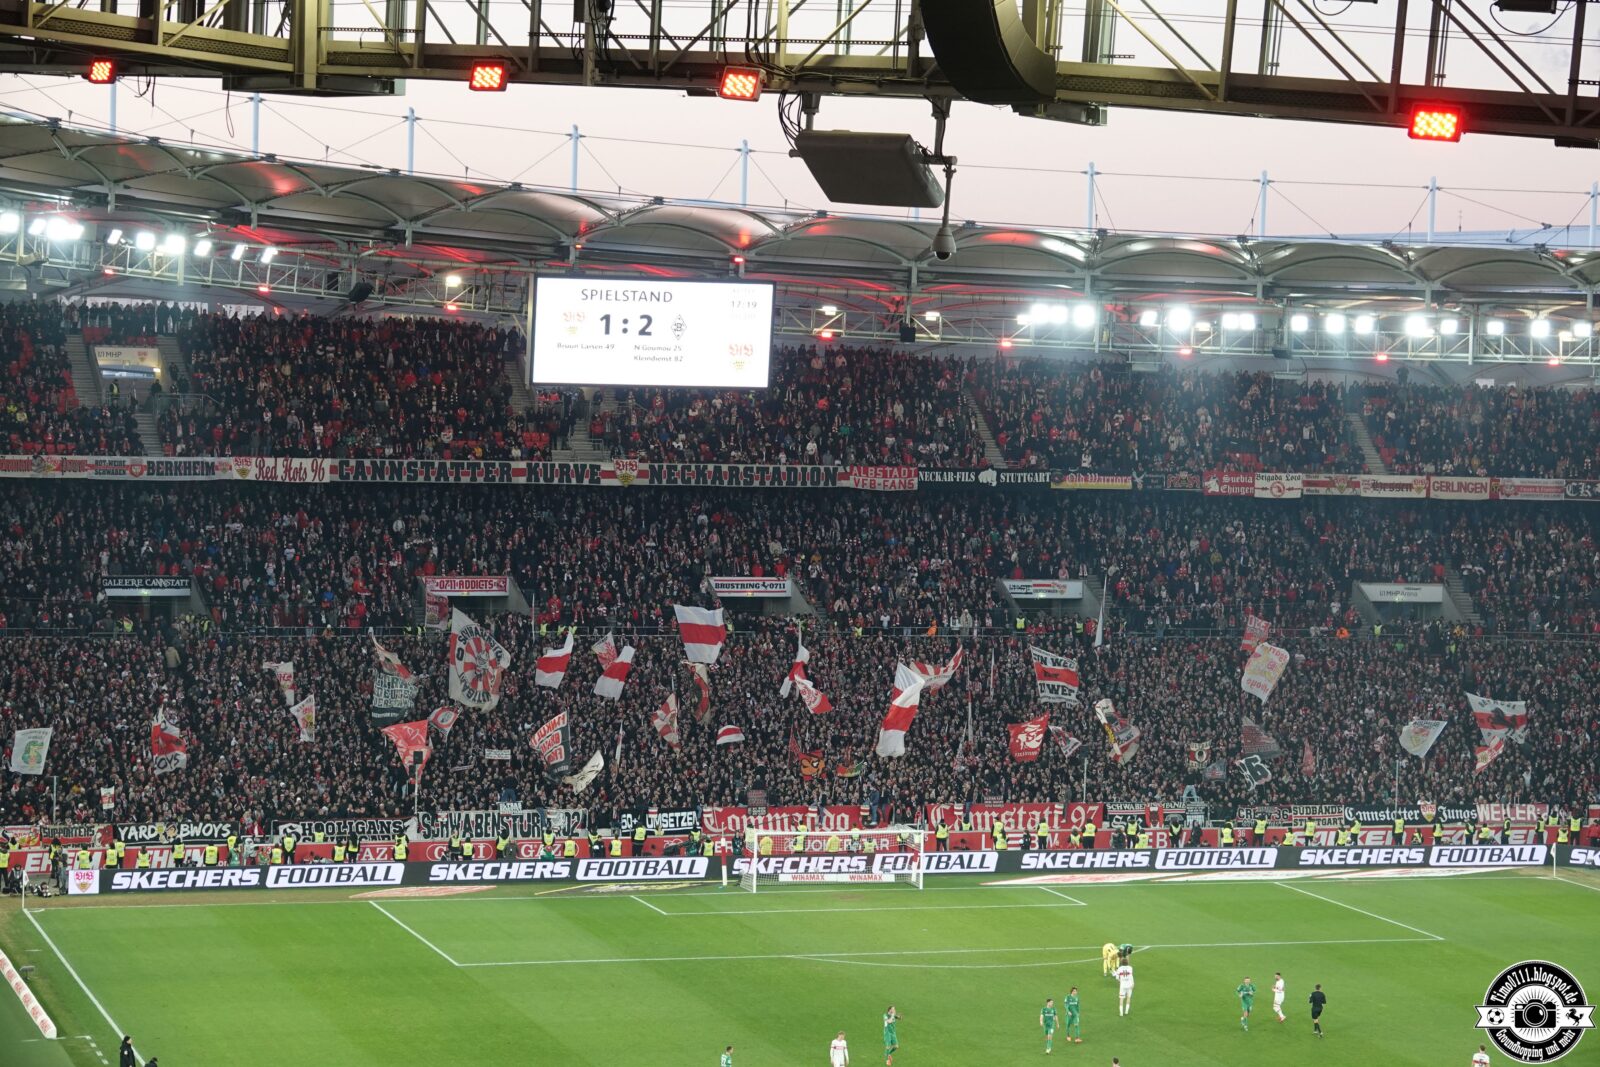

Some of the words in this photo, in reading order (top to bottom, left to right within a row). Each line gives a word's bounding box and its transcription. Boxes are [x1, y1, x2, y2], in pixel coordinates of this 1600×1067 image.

[581, 288, 673, 303] SPIELSTAND
[634, 354, 672, 362] Kleindienst
[147, 460, 215, 476] BERKHEIM
[255, 456, 278, 480] Red
[281, 456, 307, 481] Hots
[311, 457, 325, 482] 96
[338, 459, 512, 482] CANNSTATTER
[525, 461, 600, 484] KURVE
[649, 463, 839, 487] NECKARSTADION
[851, 465, 917, 479] ALBSTADT
[853, 477, 915, 490] VFB-FANS
[918, 471, 976, 483] NECKAR-FILS
[1000, 472, 1050, 484] STUTTGART
[1067, 472, 1086, 485] Old
[1087, 472, 1132, 486] Warriors
[1222, 474, 1253, 484] Suebia
[1432, 480, 1488, 495] GERLINGEN
[102, 578, 143, 588] GALEERE
[145, 578, 189, 587] CANNSTATT
[715, 582, 760, 590] BRUSTRING
[769, 582, 786, 590] 0711
[646, 810, 700, 829] UMSETZEN
[1070, 804, 1100, 831] 97
[1438, 805, 1478, 823] Jungs
[43, 826, 95, 839] SUPPORTERS
[118, 825, 157, 842] YARD
[180, 821, 231, 838] BWOYS
[300, 820, 404, 836] HOOLIGANS
[111, 868, 260, 889] SKECHERS
[274, 865, 396, 885] FOOTBALL
[429, 860, 571, 881] SKECHERS
[583, 857, 702, 877] FOOTBALL
[732, 855, 867, 875] SKECHERS
[1021, 852, 1150, 869] SKECHERS
[1162, 849, 1270, 866] FOOTBALL
[1299, 848, 1425, 866] SKECHERS
[1435, 846, 1543, 863] FOOTBALL
[791, 874, 825, 882] WINAMAX
[849, 874, 883, 882] WINAMAX
